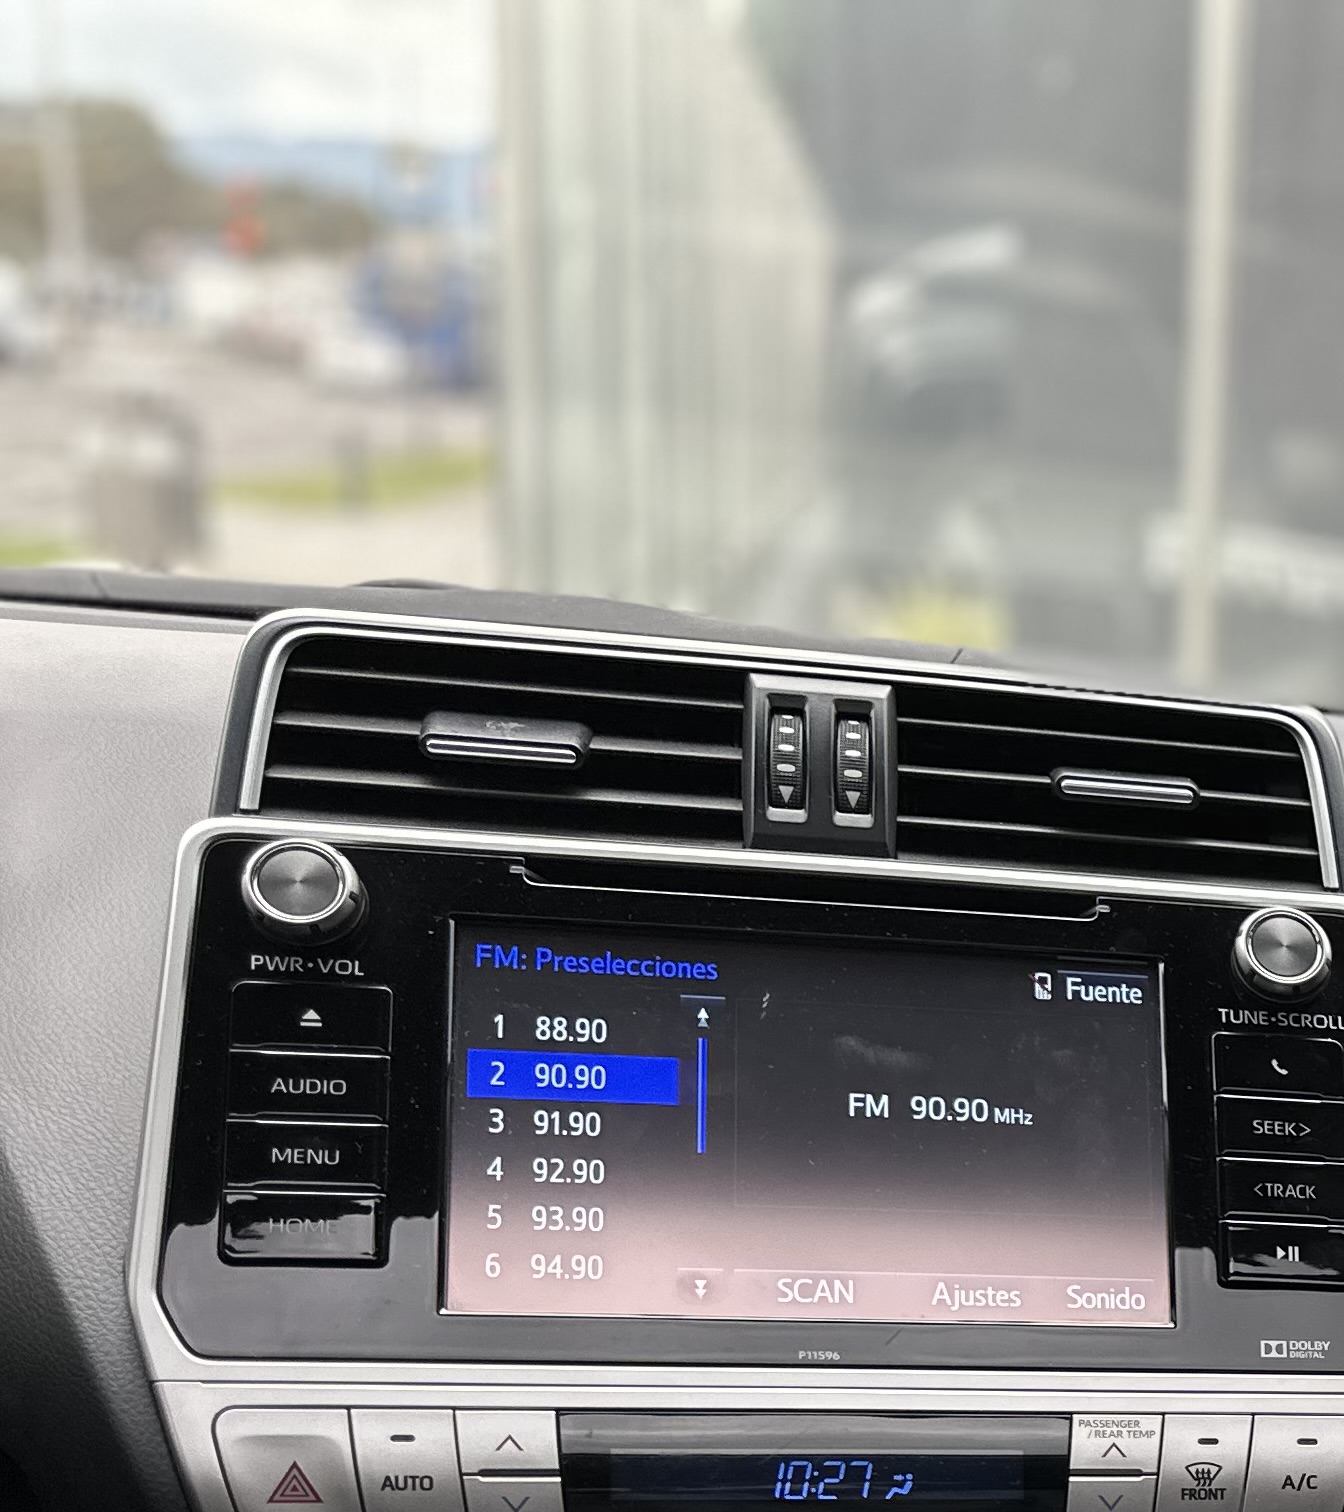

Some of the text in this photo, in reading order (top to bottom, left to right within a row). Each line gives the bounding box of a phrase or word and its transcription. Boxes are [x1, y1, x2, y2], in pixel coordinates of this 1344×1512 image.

[475, 943, 719, 980] FM: Preselecciones
[1066, 977, 1143, 1005] Fuente
[493, 1013, 608, 1043] 1 88.90
[271, 1077, 347, 1097] AUDIO
[489, 1061, 607, 1090] 2 90.90
[848, 1092, 1034, 1126] FM 90.90 MHz
[488, 1108, 601, 1137] 3 91.90
[271, 1147, 340, 1166] MENU
[486, 1156, 605, 1184] 4 92.90
[486, 1204, 604, 1231] 5 93.90
[485, 1253, 603, 1279] 6 94.90
[776, 1277, 855, 1304] SCAN
[931, 1281, 1022, 1311] Ajustes
[1066, 1285, 1146, 1311] Sonido
[798, 1350, 841, 1361] P11596
[1289, 1340, 1331, 1351] DOLBY
[1289, 1350, 1325, 1359] DIGITAL
[1078, 1418, 1141, 1429] PASSENGER
[1126, 1429, 1156, 1439] TEMP
[381, 1474, 434, 1492] AUTO
[773, 1459, 873, 1501] 10:27
[1282, 1473, 1319, 1492] A/C
[1181, 1487, 1227, 1502] FRONT
